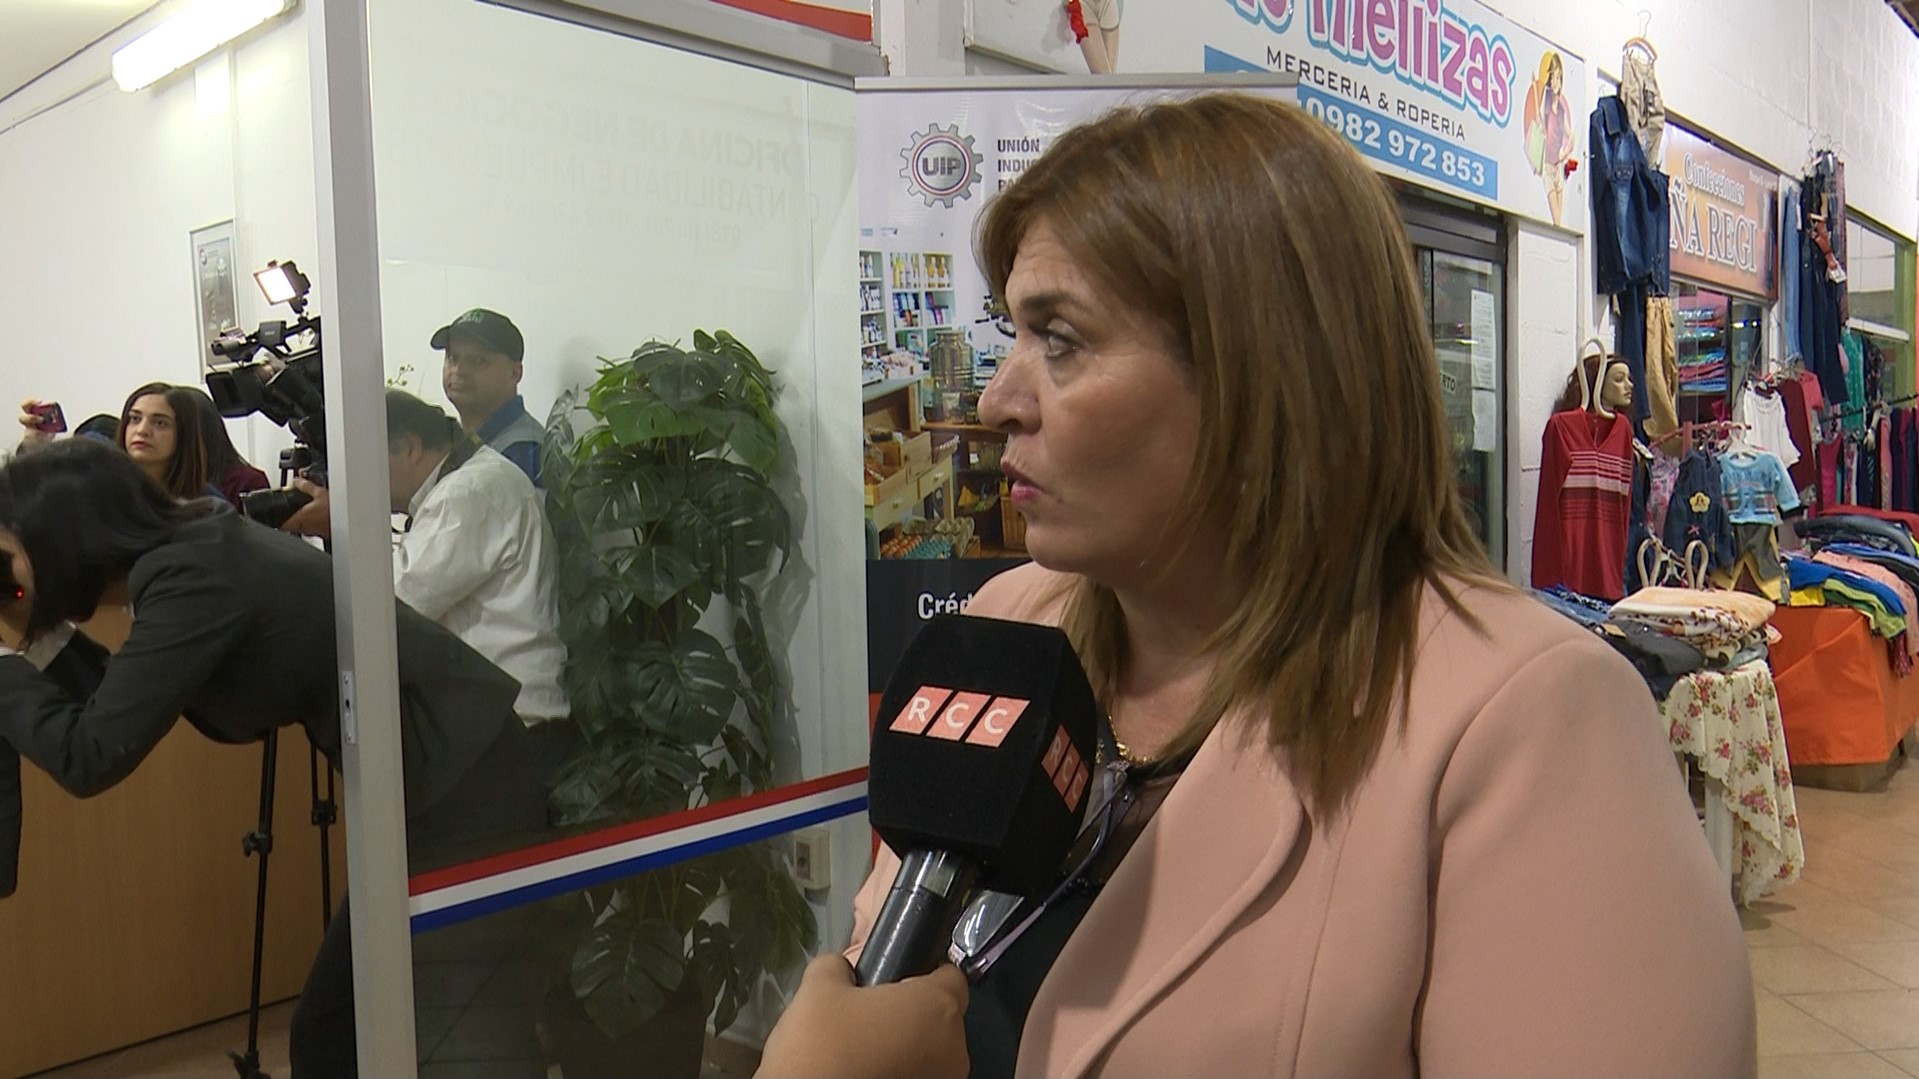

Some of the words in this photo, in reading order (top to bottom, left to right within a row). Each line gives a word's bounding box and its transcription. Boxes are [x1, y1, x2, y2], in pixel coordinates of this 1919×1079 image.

[1266, 46, 1370, 104] MERCERIA
[1378, 92, 1389, 111] &
[1397, 100, 1465, 141] ROPERIA
[921, 157, 961, 176] UIP
[998, 136, 1040, 153] UNIÓN
[1306, 98, 1381, 149] 0982
[1388, 124, 1436, 170] 972
[1442, 150, 1485, 187] 853
[1670, 175, 1704, 256] ÑA
[1707, 204, 1757, 272] REGI
[908, 697, 1007, 734] RCC
[1050, 738, 1082, 803] RCC
